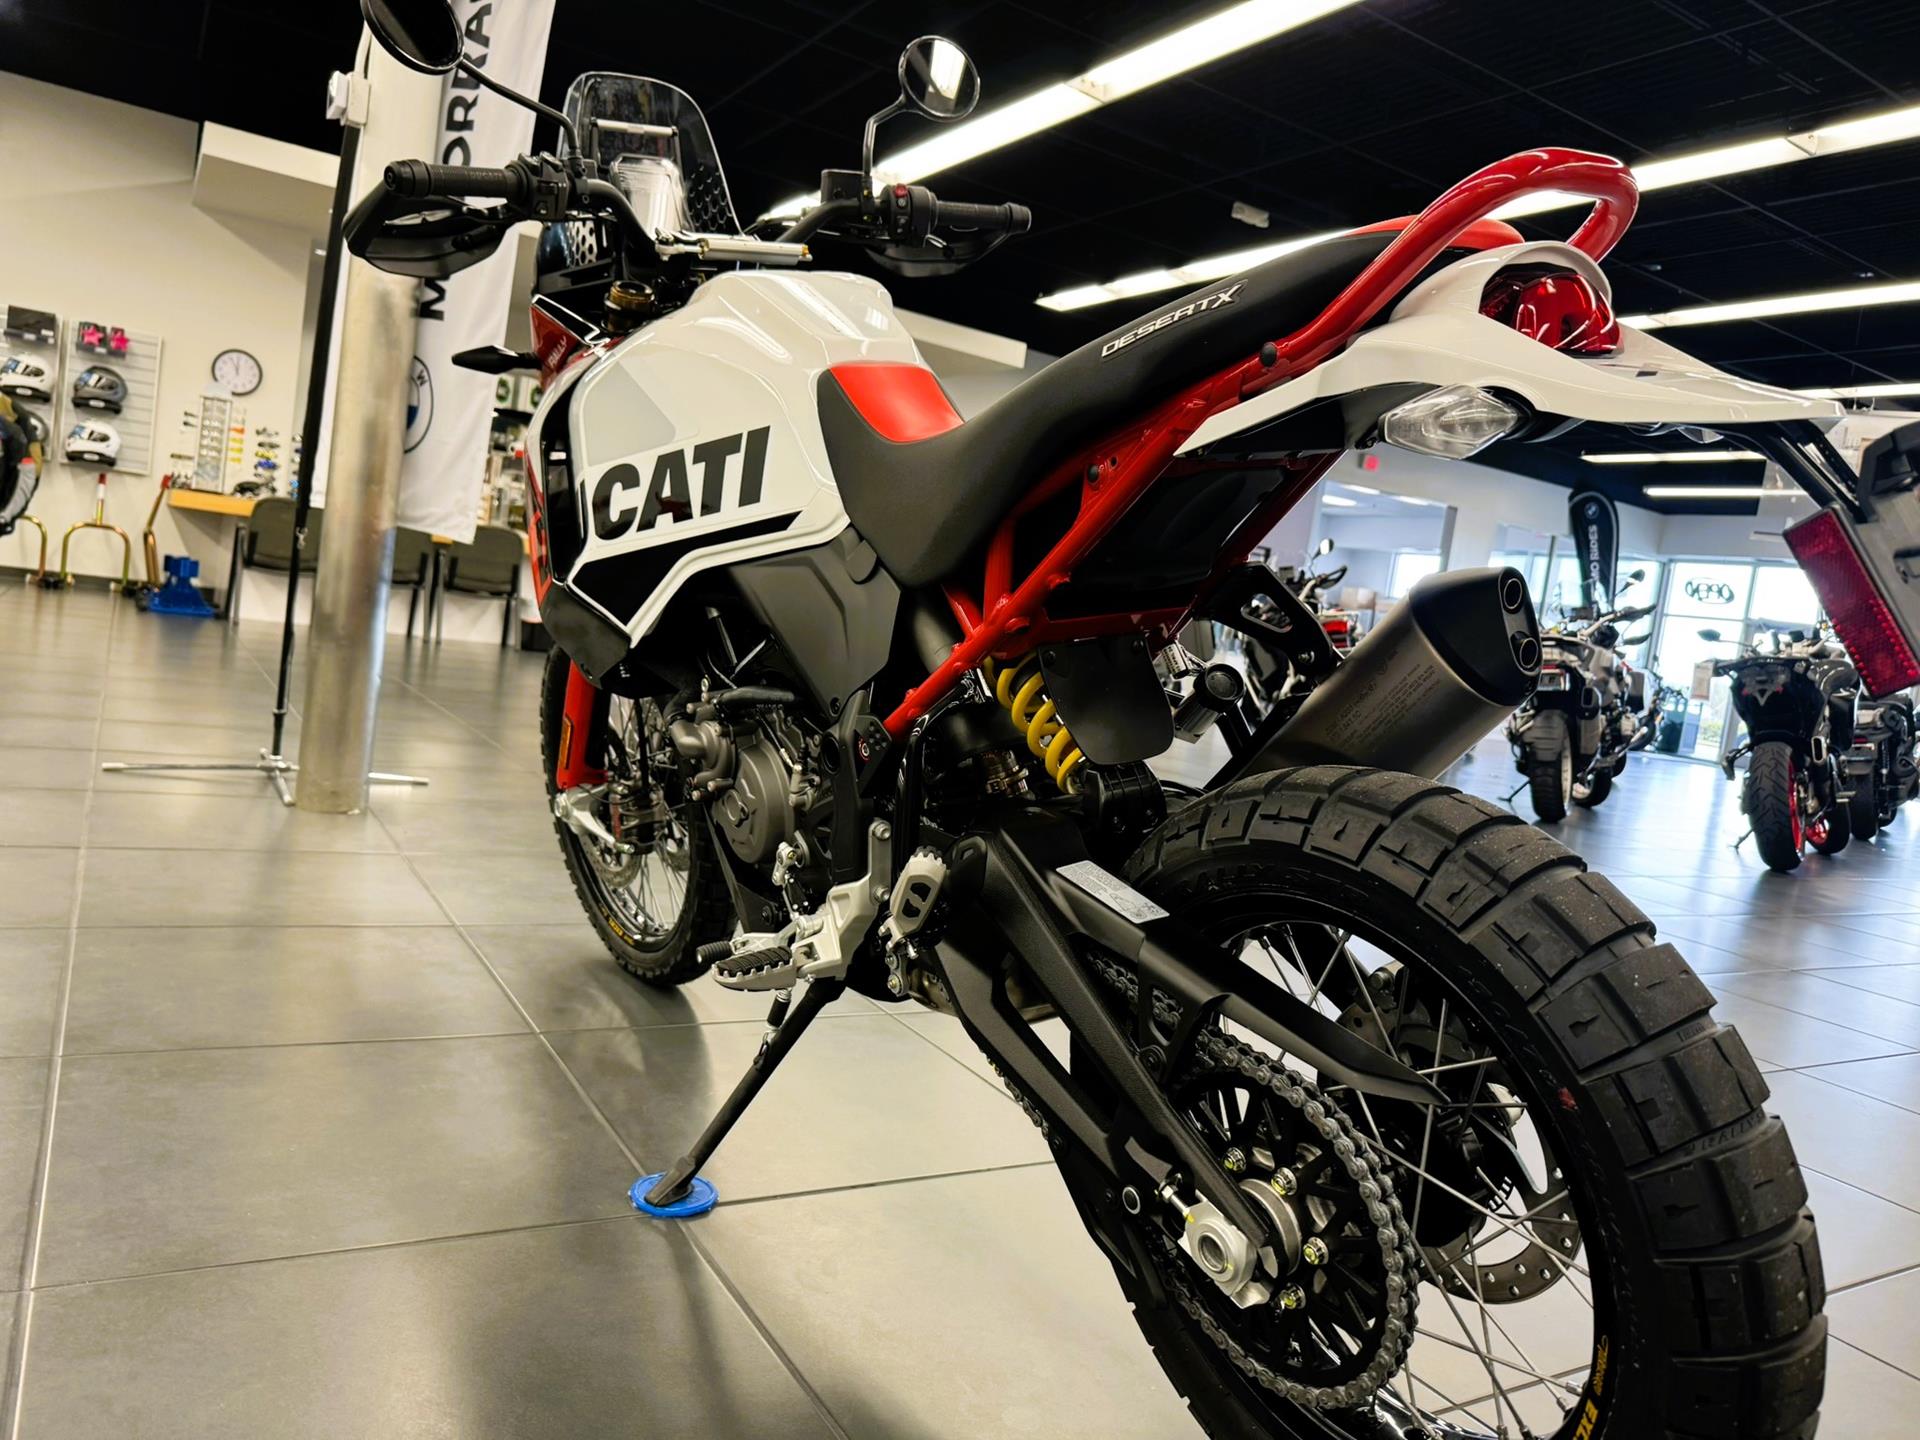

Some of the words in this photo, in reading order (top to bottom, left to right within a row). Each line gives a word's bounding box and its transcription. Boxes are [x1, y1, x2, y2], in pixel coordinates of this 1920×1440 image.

[417, 0, 492, 321] MORRA
[1101, 284, 1242, 357] DESERTX
[580, 425, 771, 540] CATI
[1588, 524, 1600, 561] RIDES
